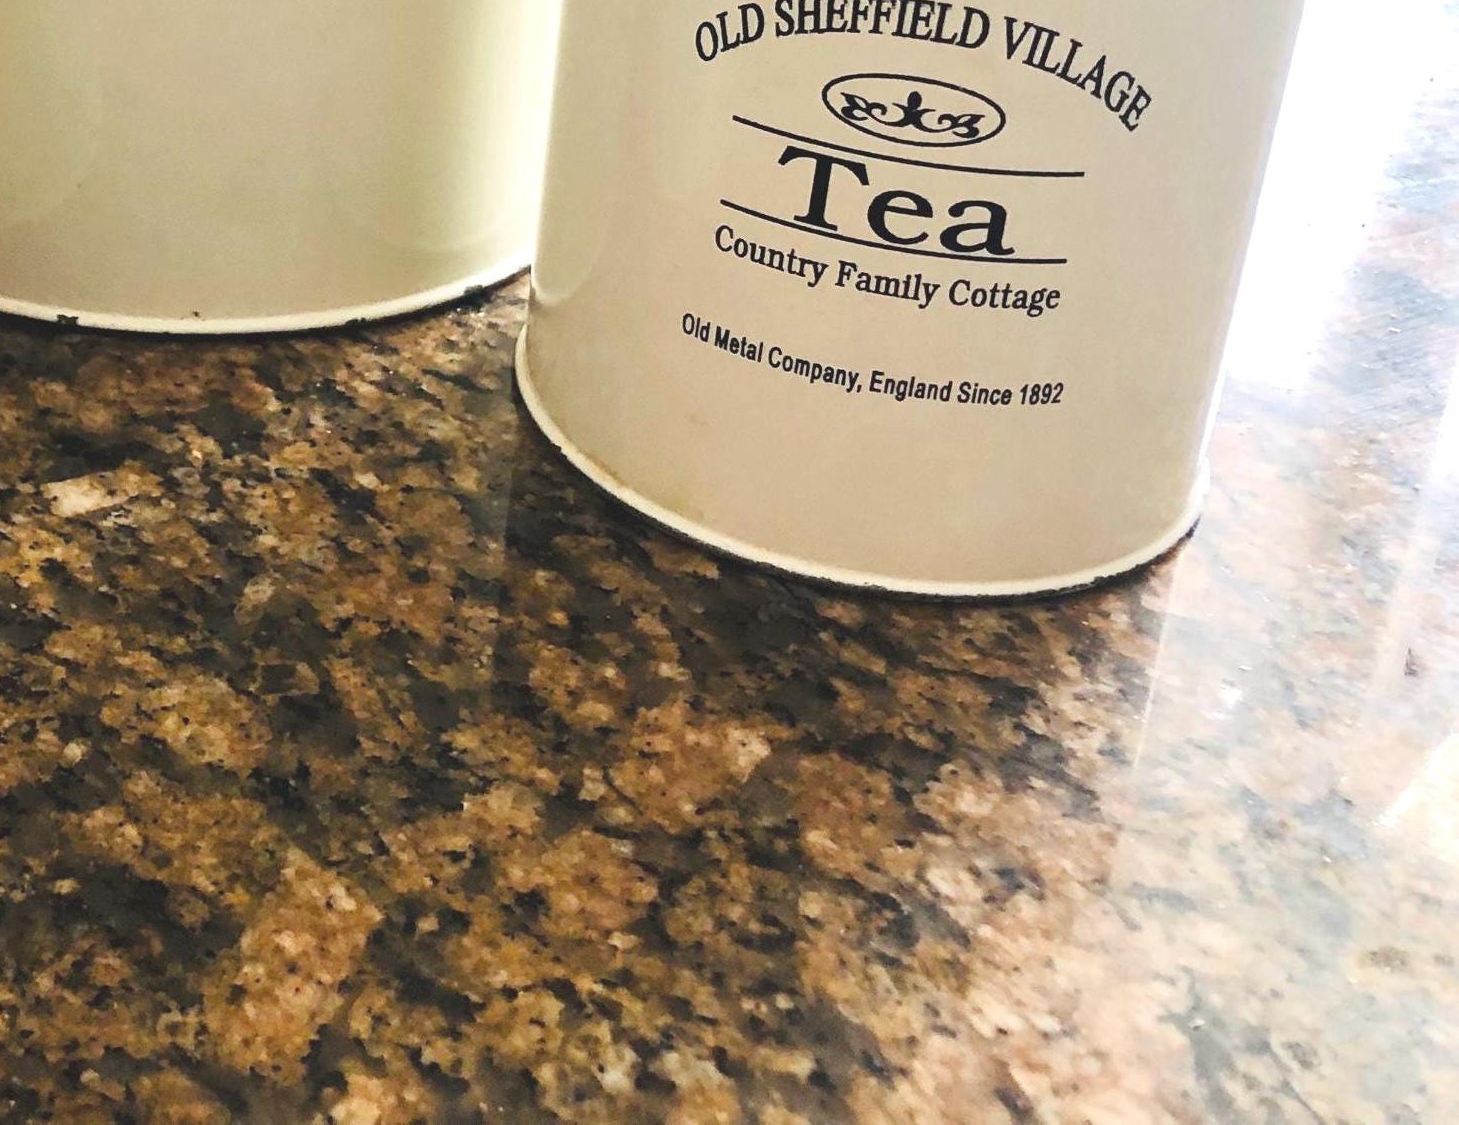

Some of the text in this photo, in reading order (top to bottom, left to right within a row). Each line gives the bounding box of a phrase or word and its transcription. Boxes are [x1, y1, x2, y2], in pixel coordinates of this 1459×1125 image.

[695, 2, 765, 62] OLD
[1003, 15, 1152, 132] VILLAGE
[777, 145, 1016, 256] Tea
[715, 224, 1061, 318] Country Family Cottage
[682, 312, 1064, 406] Old Metal Company, England Since 1892
